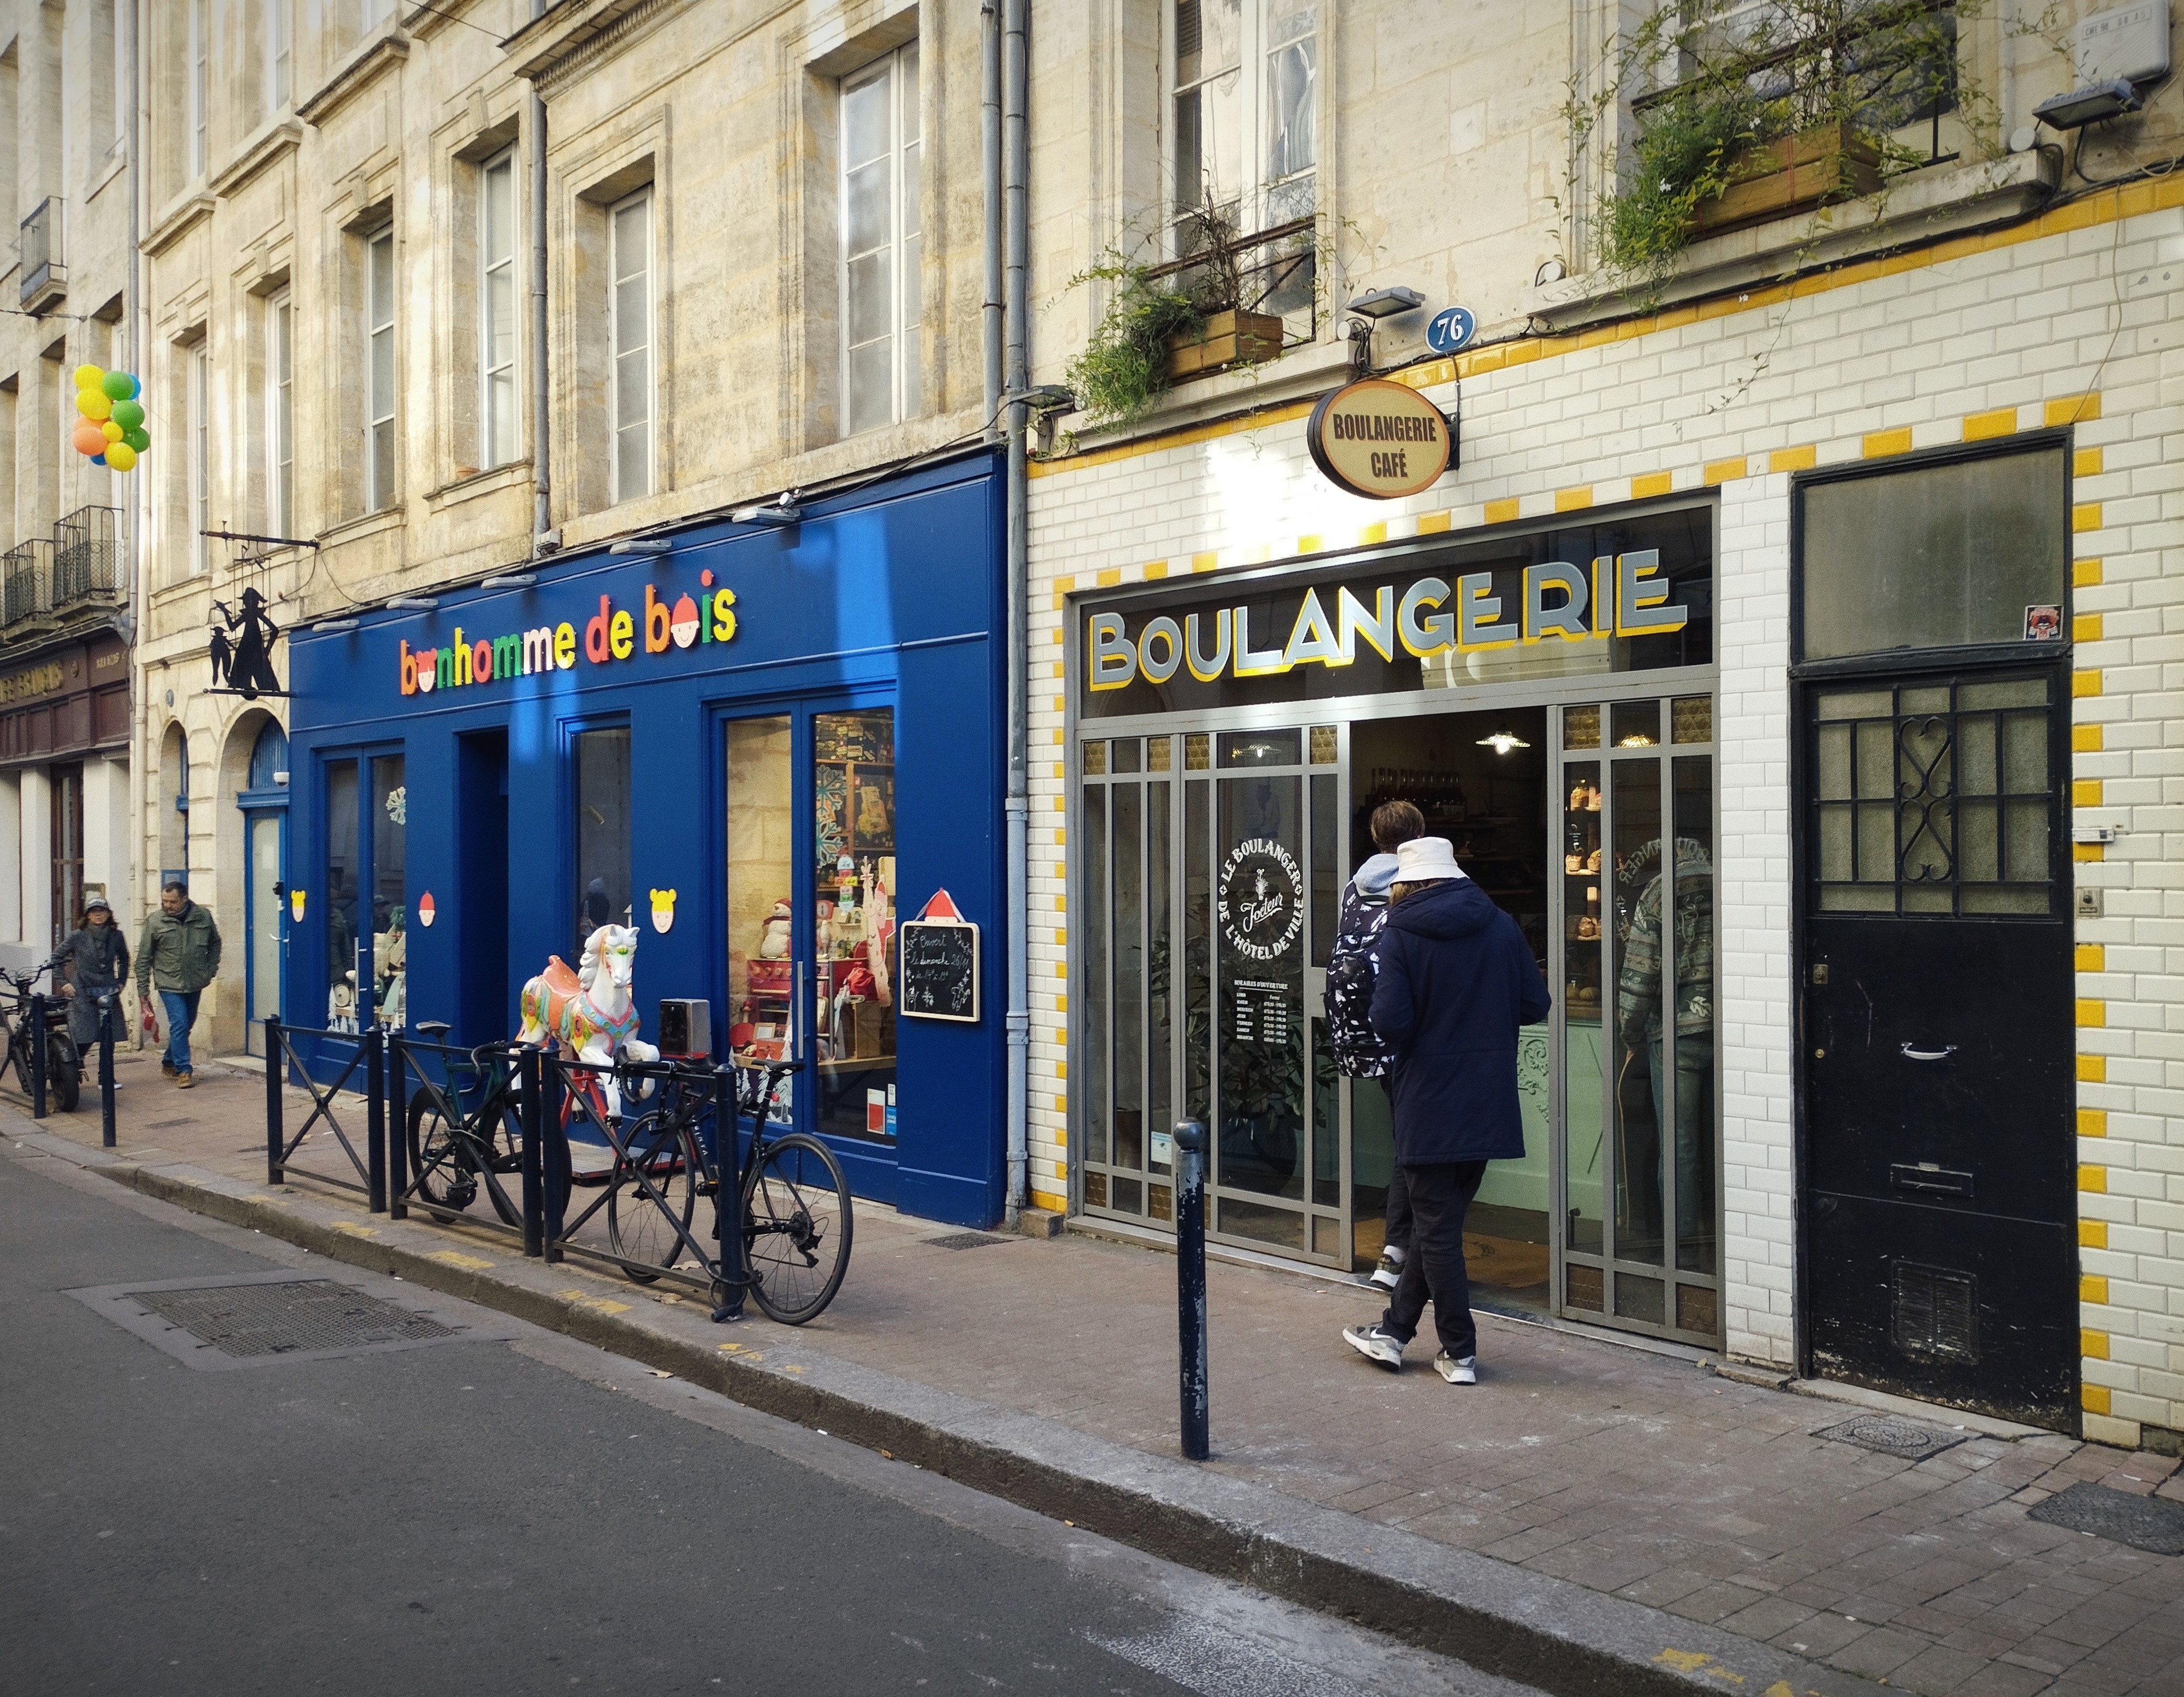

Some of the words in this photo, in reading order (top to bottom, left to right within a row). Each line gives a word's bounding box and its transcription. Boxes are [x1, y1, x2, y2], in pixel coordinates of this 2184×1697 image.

[1437, 314, 1464, 346] 76
[1333, 414, 1437, 442] BOULANGERIE
[1370, 449, 1408, 478] CAFÉ
[400, 622, 576, 696] bonhomme
[585, 594, 634, 664] de
[645, 568, 738, 653] bois
[1089, 549, 1688, 692] BOULANGERIE
[1221, 859, 1236, 883] LE
[1231, 838, 1301, 886] BOULANGER
[1218, 901, 1231, 923] DE
[1226, 924, 1273, 960] L'HÔTEL
[1272, 936, 1290, 956] DE
[1285, 898, 1304, 941] VILLE
[920, 951, 950, 965] dimanche
